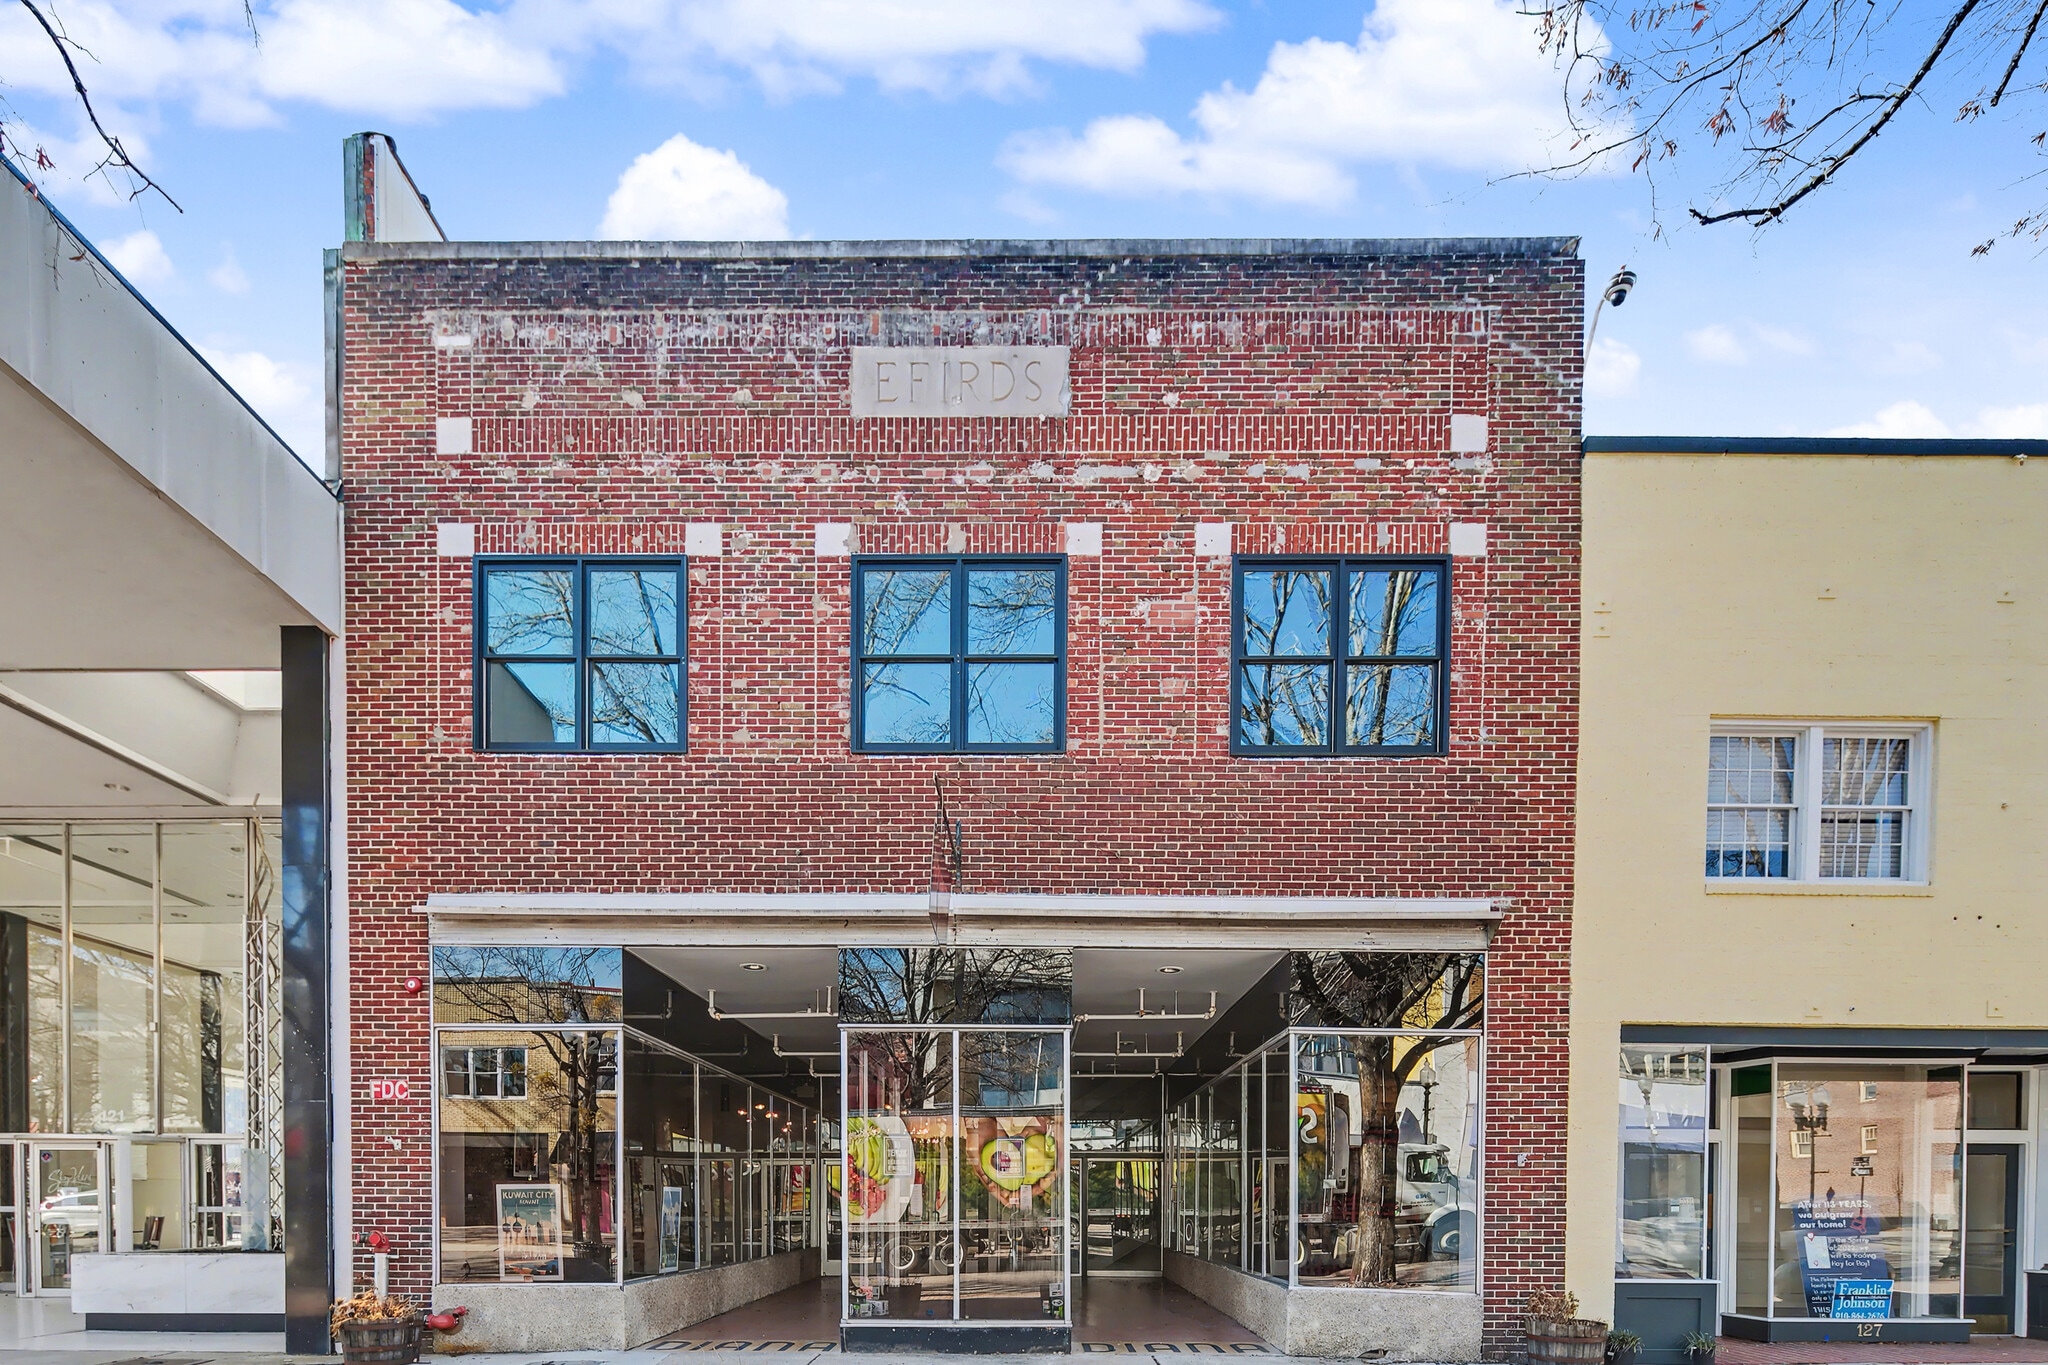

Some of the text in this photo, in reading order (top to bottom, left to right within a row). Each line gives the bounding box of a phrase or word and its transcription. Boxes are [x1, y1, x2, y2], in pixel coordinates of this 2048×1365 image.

[370, 1080, 408, 1099] FDC
[502, 1191, 554, 1199] KUWAIT CITY
[1838, 1283, 1888, 1295] Franklin
[1837, 1296, 1886, 1310] Johnson
[1856, 1323, 1883, 1337] 127
[647, 1340, 838, 1351] DIANA
[1081, 1342, 1271, 1353] DIANA
